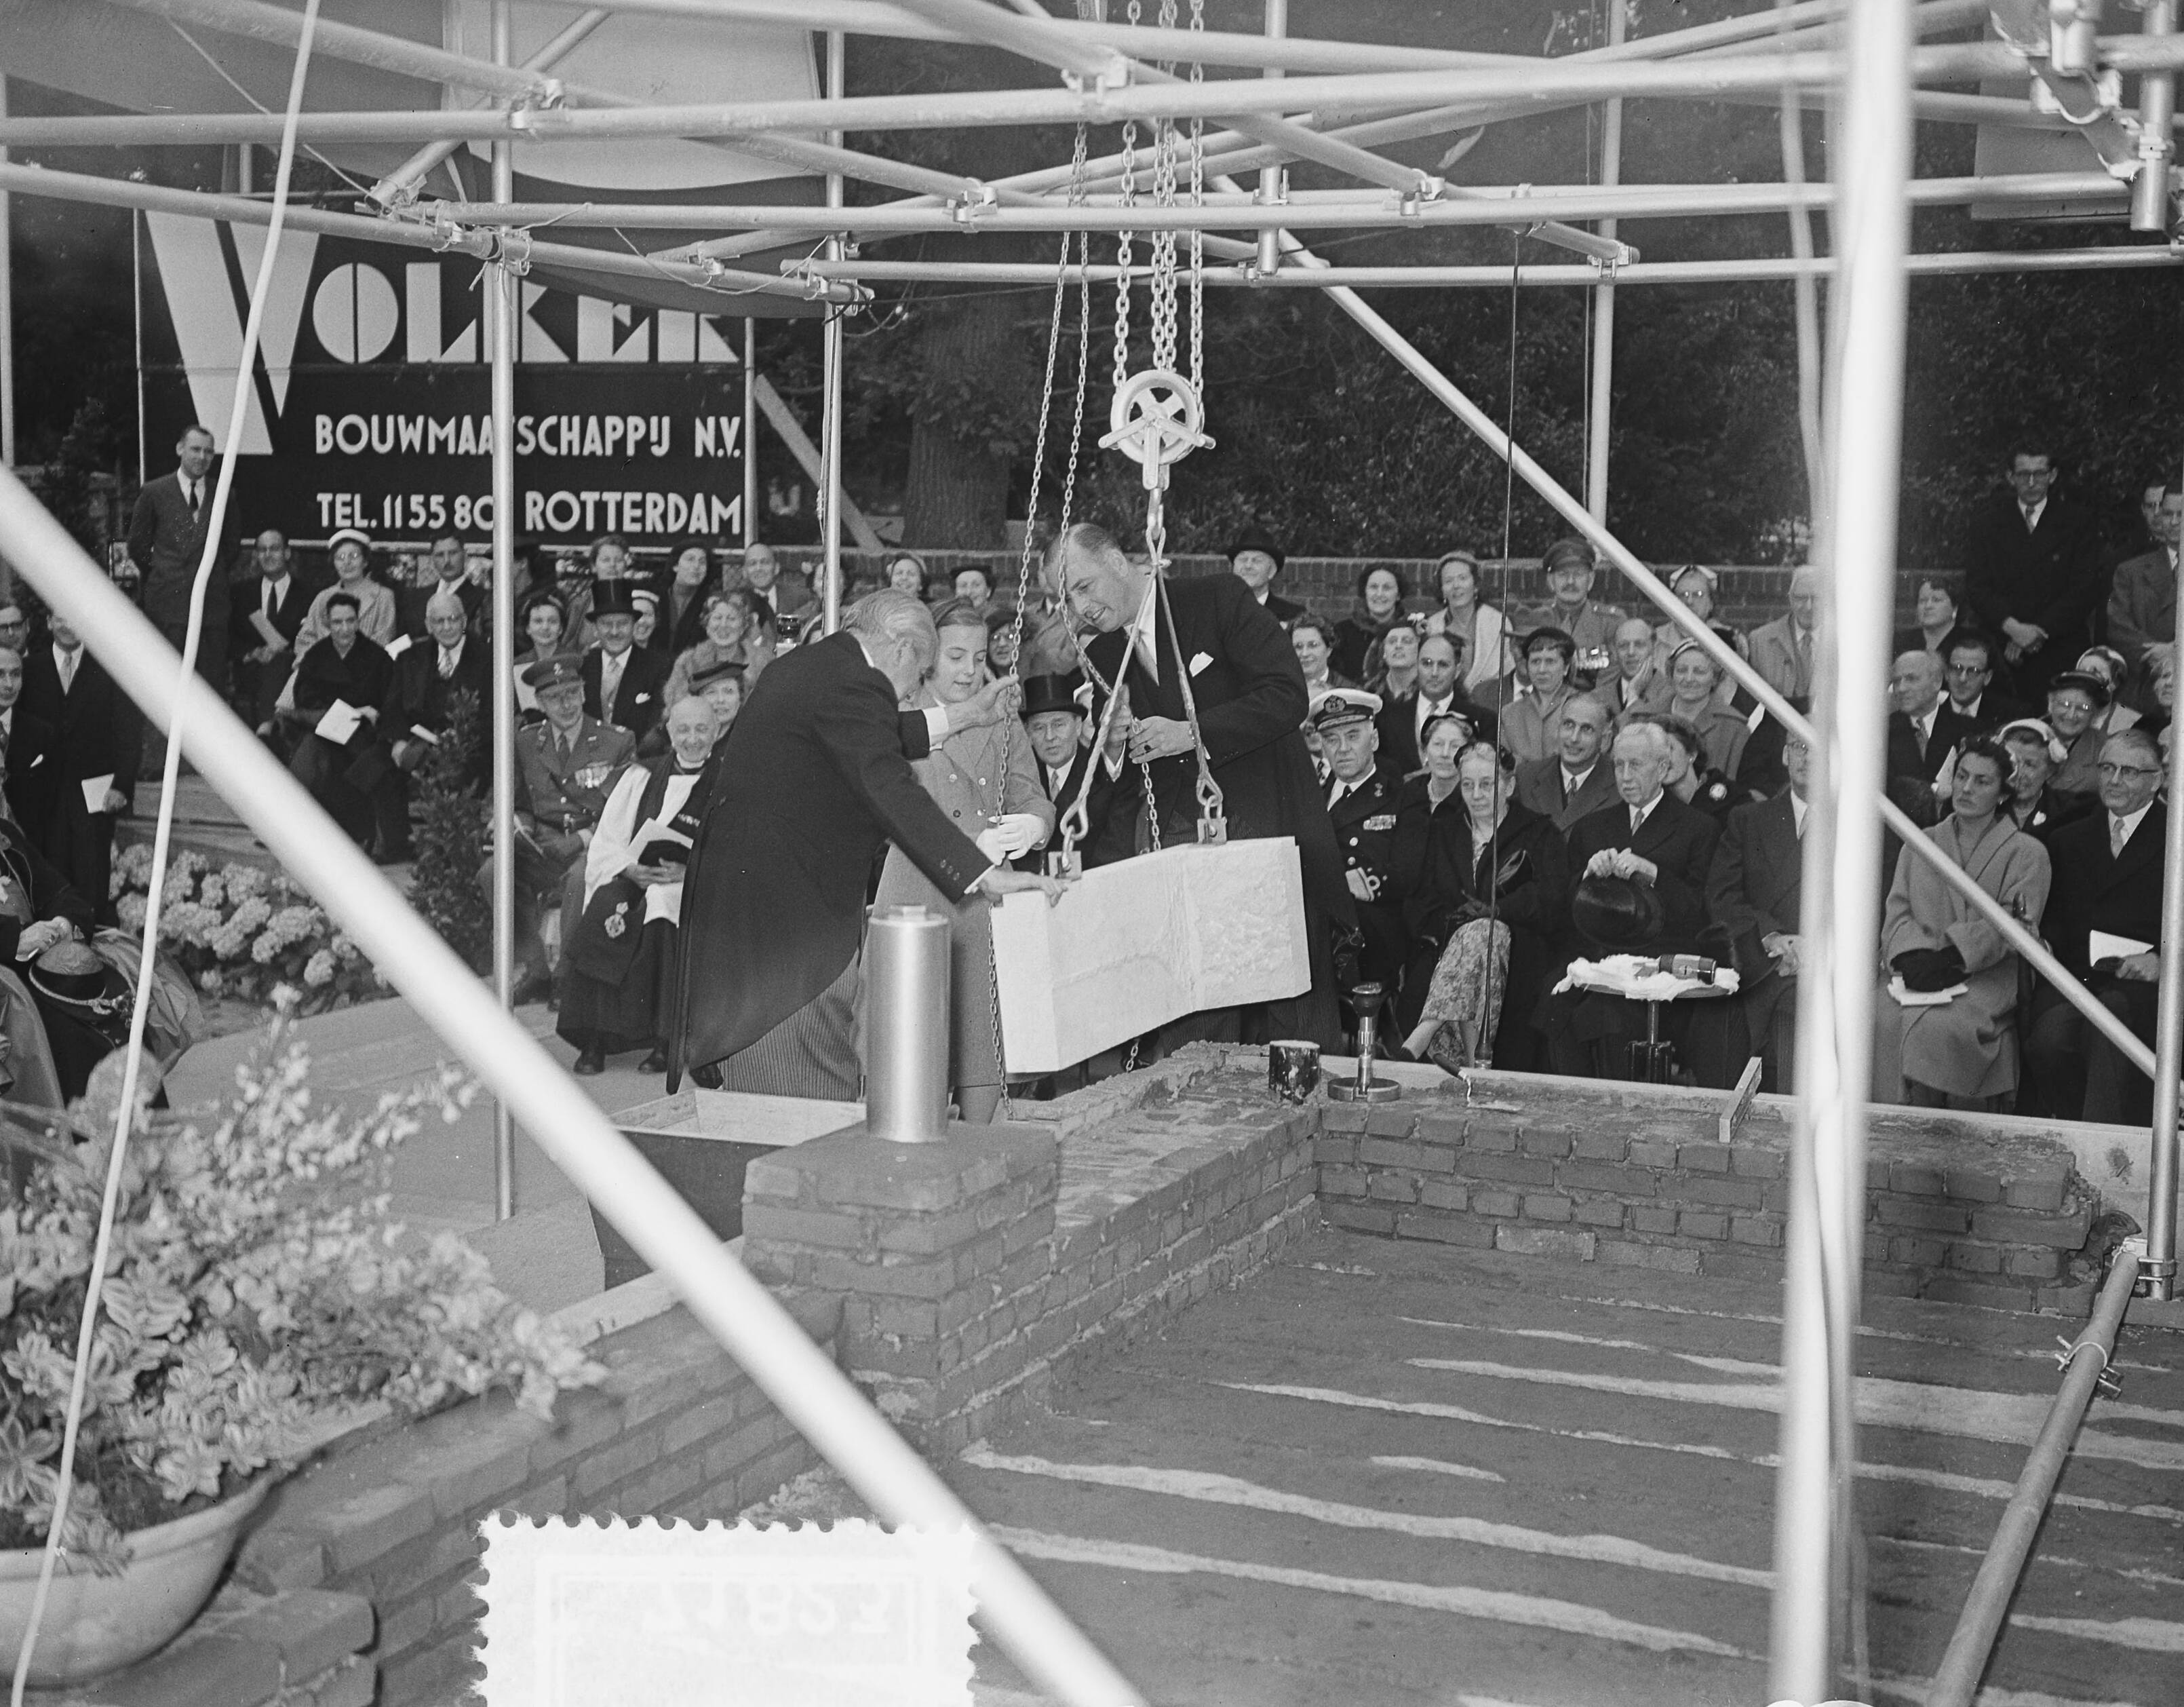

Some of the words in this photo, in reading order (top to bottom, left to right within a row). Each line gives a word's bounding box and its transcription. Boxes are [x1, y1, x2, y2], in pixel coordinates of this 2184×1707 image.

[315, 413, 671, 457] BOUWMAASCHAPPIJ
[694, 416, 741, 457] N.V.
[525, 490, 741, 535] ROTTERDAM
